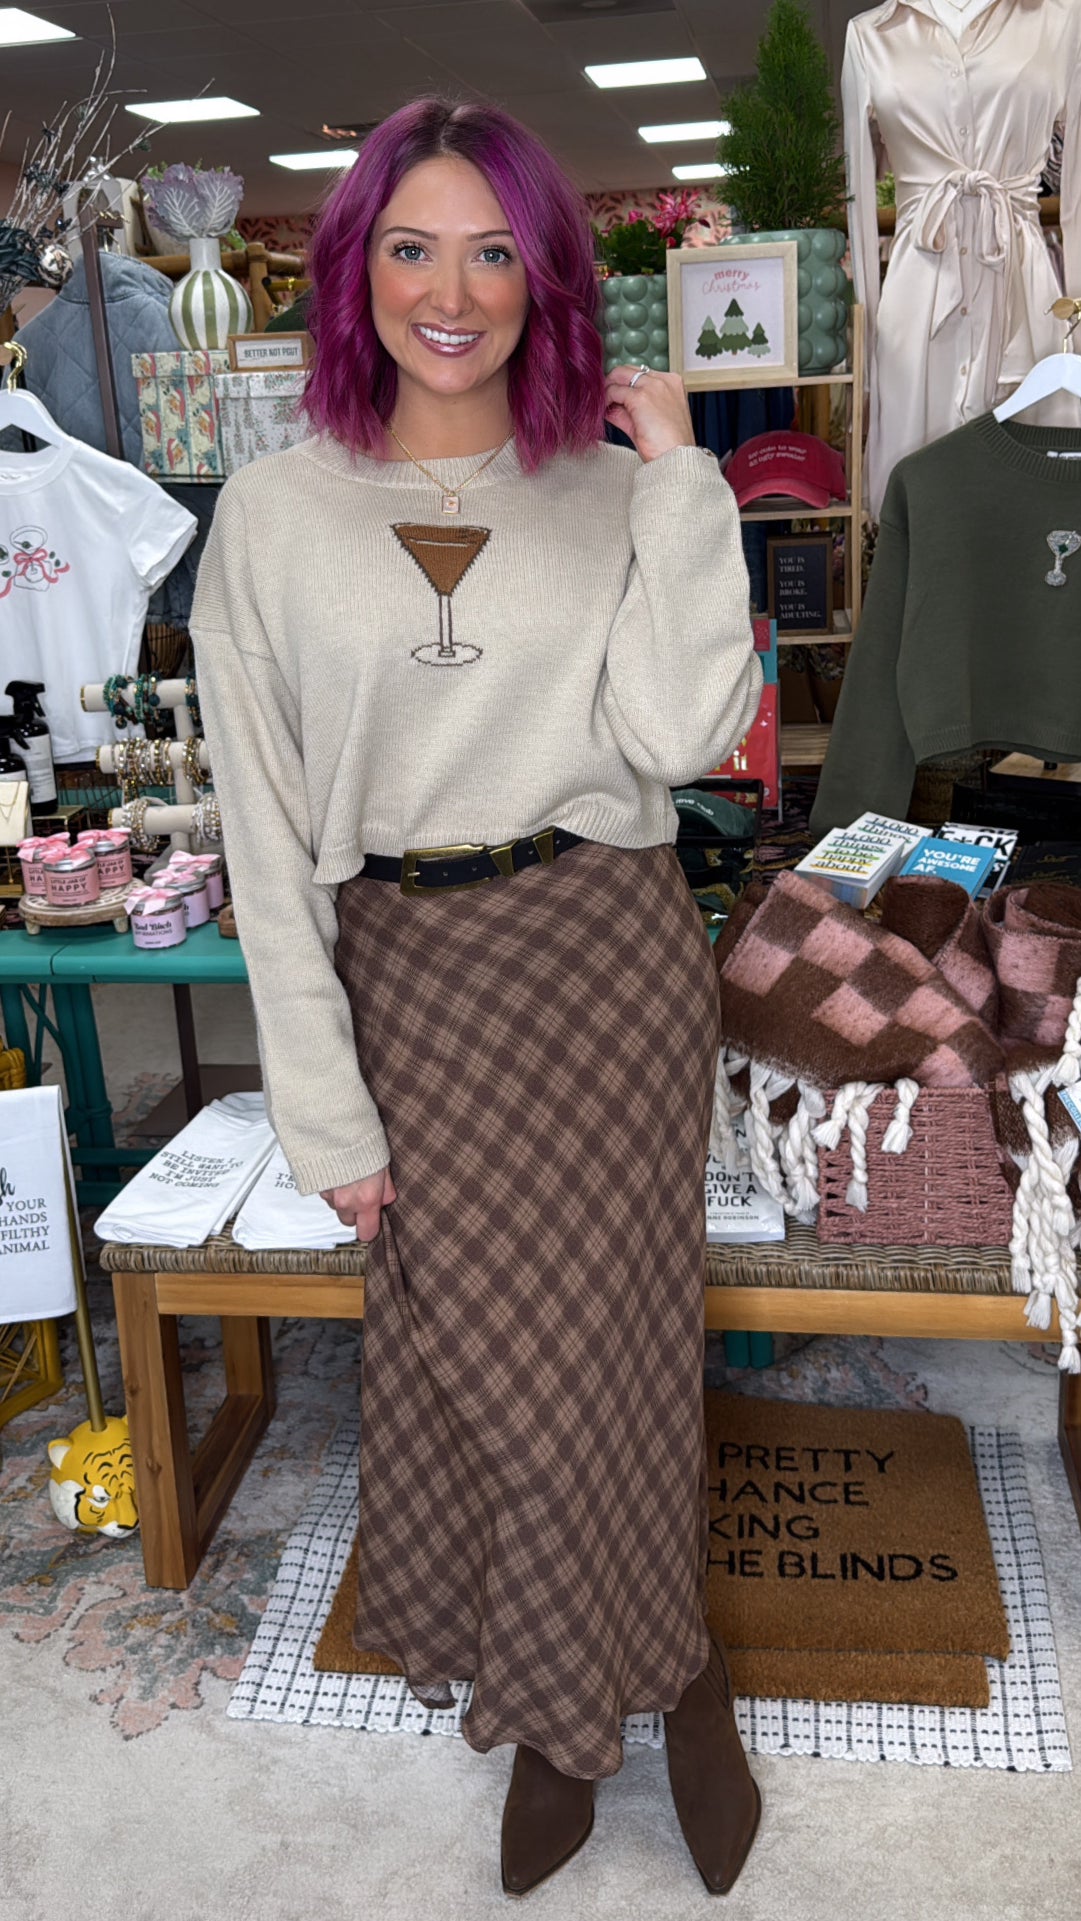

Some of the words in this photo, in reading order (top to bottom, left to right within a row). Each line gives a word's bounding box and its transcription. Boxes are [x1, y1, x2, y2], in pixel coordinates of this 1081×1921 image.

[714, 269, 750, 281] merry
[244, 348, 268, 358] BETTER
[269, 347, 281, 357] NOT
[282, 347, 298, 357] POUT
[779, 556, 795, 564] YOU
[797, 556, 805, 564] IS
[779, 580, 795, 588] YOU
[779, 603, 795, 611] YOU
[832, 847, 850, 856] to
[853, 848, 874, 857] be
[923, 848, 982, 866] YOU'RE
[821, 852, 872, 865] happy
[912, 863, 937, 875] AF.
[917, 857, 978, 873] AWESOME
[51, 883, 87, 892] HAPPY
[160, 1151, 195, 1168] STILL
[181, 1150, 224, 1163] LISTEN
[162, 1160, 180, 1170] BE
[180, 1166, 231, 1176] INVITED
[148, 1172, 174, 1184] NOT
[165, 1170, 184, 1180] I'M
[705, 1171, 755, 1182] DON'T
[746, 1184, 757, 1194] A
[6, 1197, 48, 1212] YOUR
[707, 1195, 752, 1207] FUCK
[0, 1211, 48, 1227] HANDS
[0, 1225, 50, 1241] FILTHY
[718, 1441, 895, 1474] PRETTY
[777, 1550, 959, 1583] BLINDS
